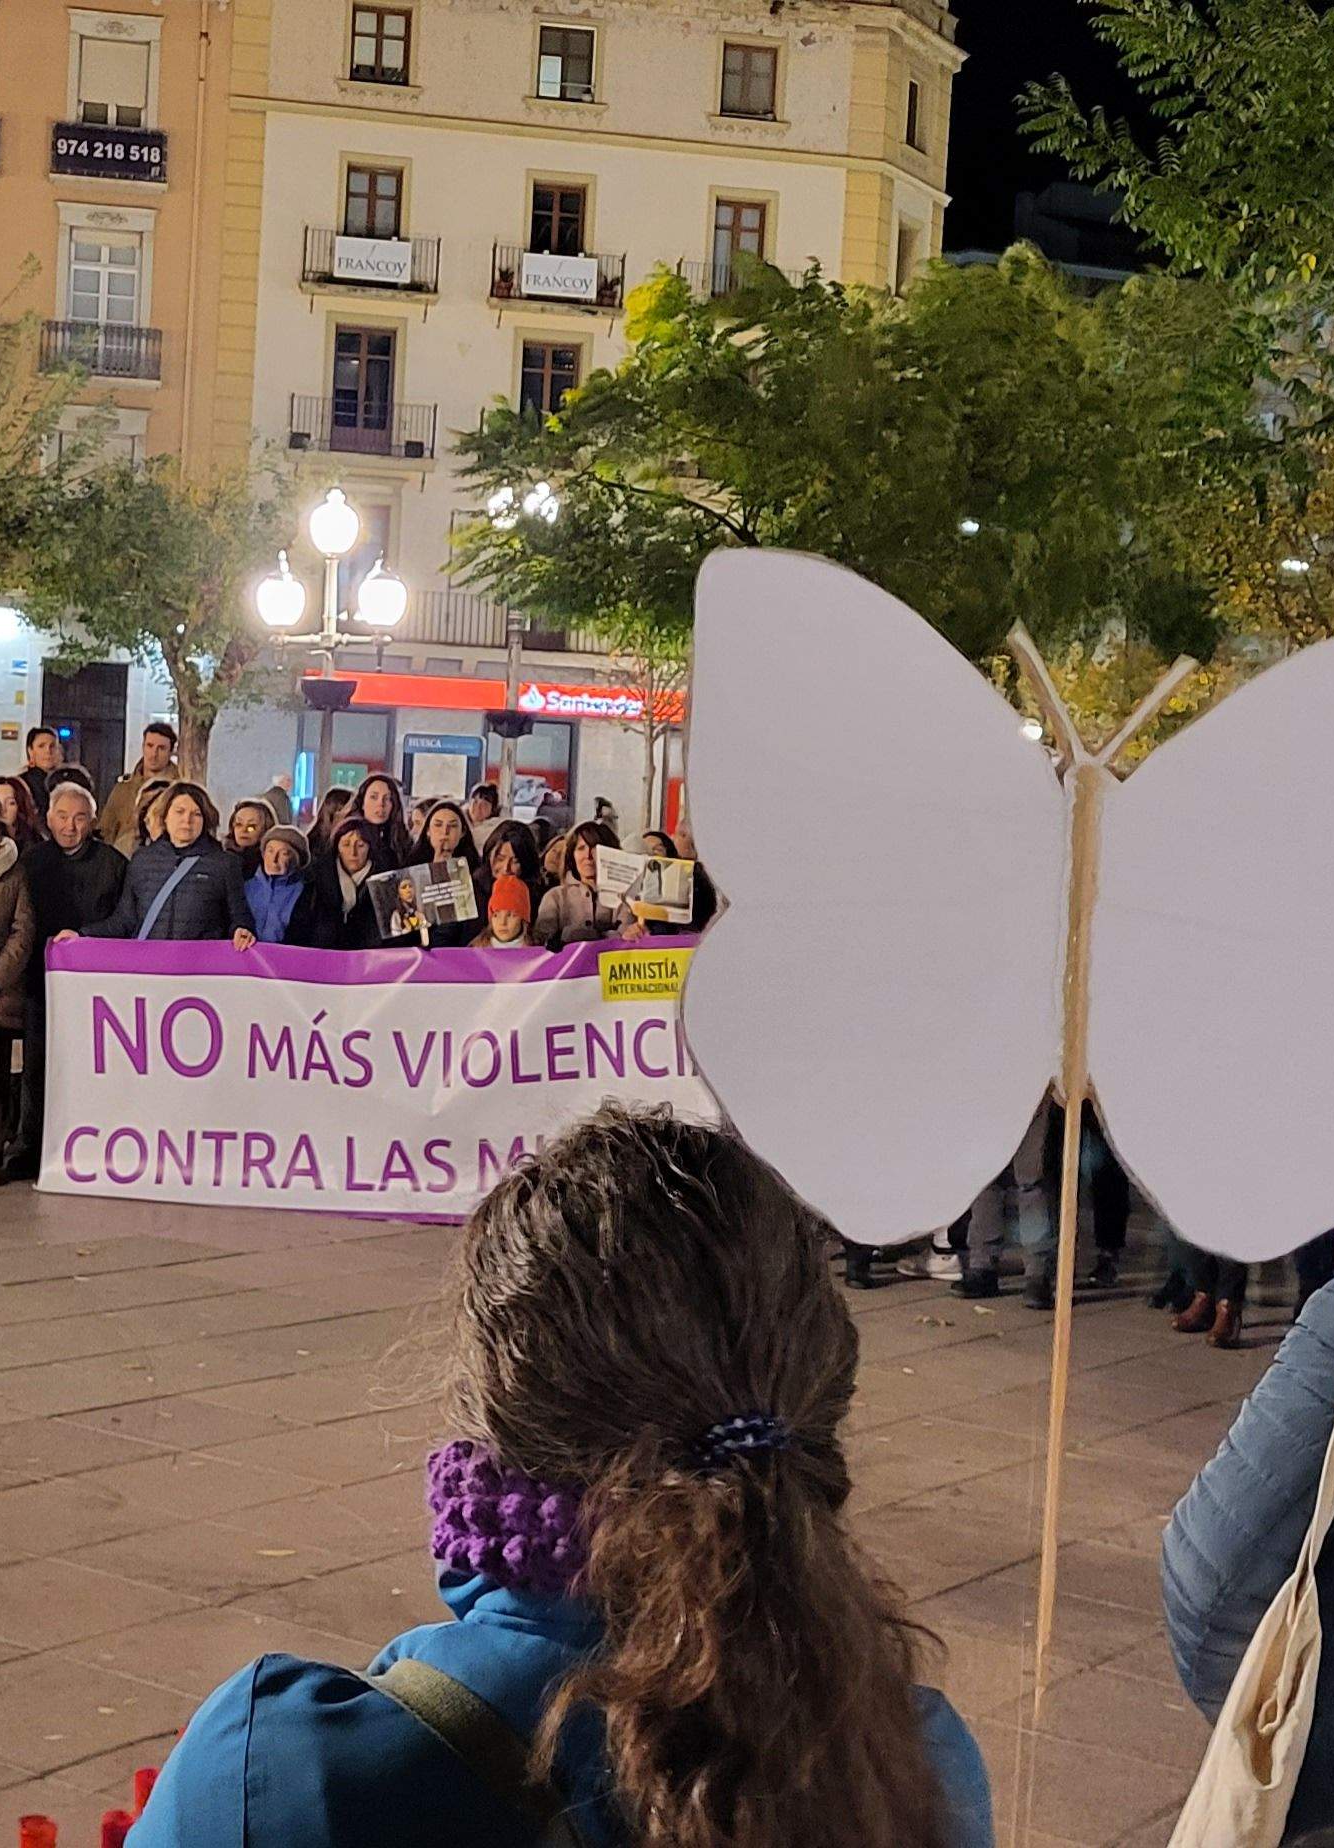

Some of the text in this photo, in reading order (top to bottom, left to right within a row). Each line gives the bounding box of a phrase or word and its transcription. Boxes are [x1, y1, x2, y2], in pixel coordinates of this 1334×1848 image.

[57, 138, 161, 163] 974 218 518
[608, 961, 679, 982] AMNISTÍA
[93, 995, 700, 1088] NO MÁS VIOLENCI
[64, 1126, 325, 1191] CONTRA
[346, 1136, 458, 1194] LAS
